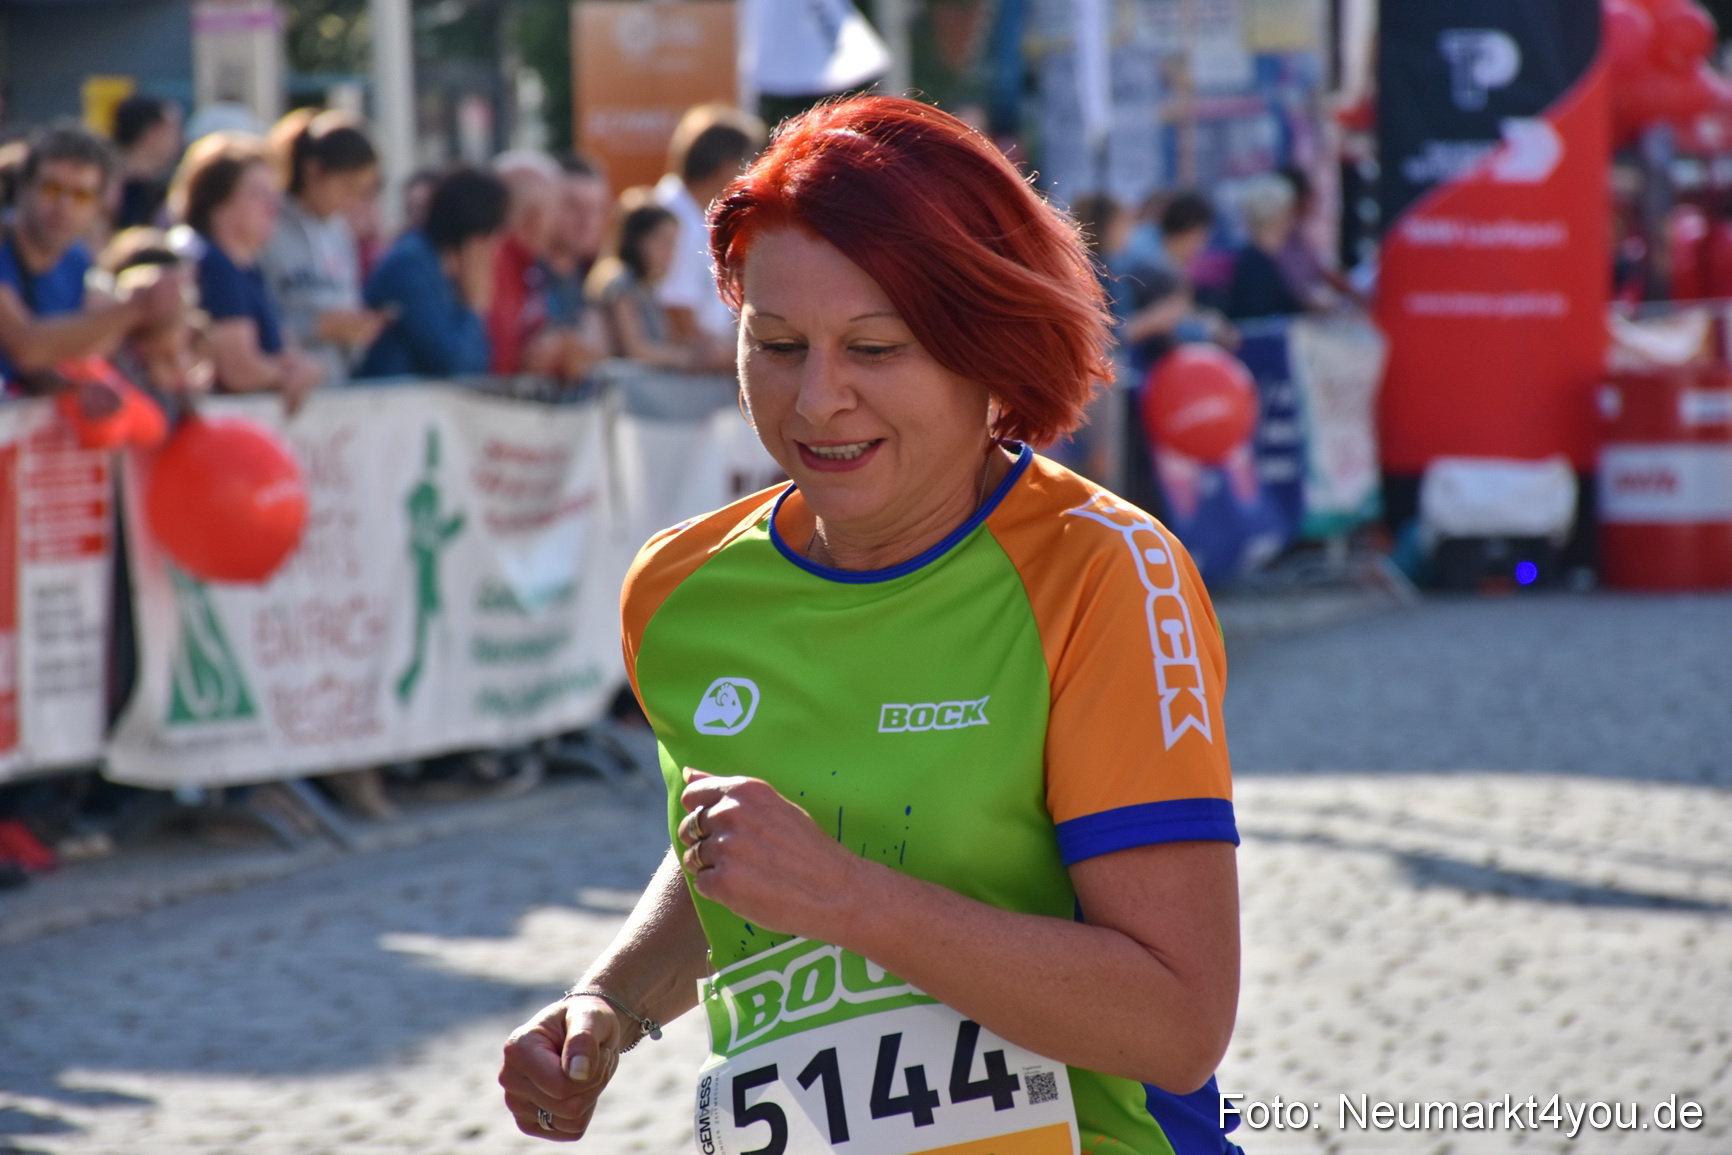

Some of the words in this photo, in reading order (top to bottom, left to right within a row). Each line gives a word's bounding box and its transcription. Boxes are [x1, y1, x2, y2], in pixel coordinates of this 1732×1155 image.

[1064, 491, 1213, 751] BOCK
[878, 696, 990, 732] BOCK
[732, 1019, 1020, 1155] 5144
